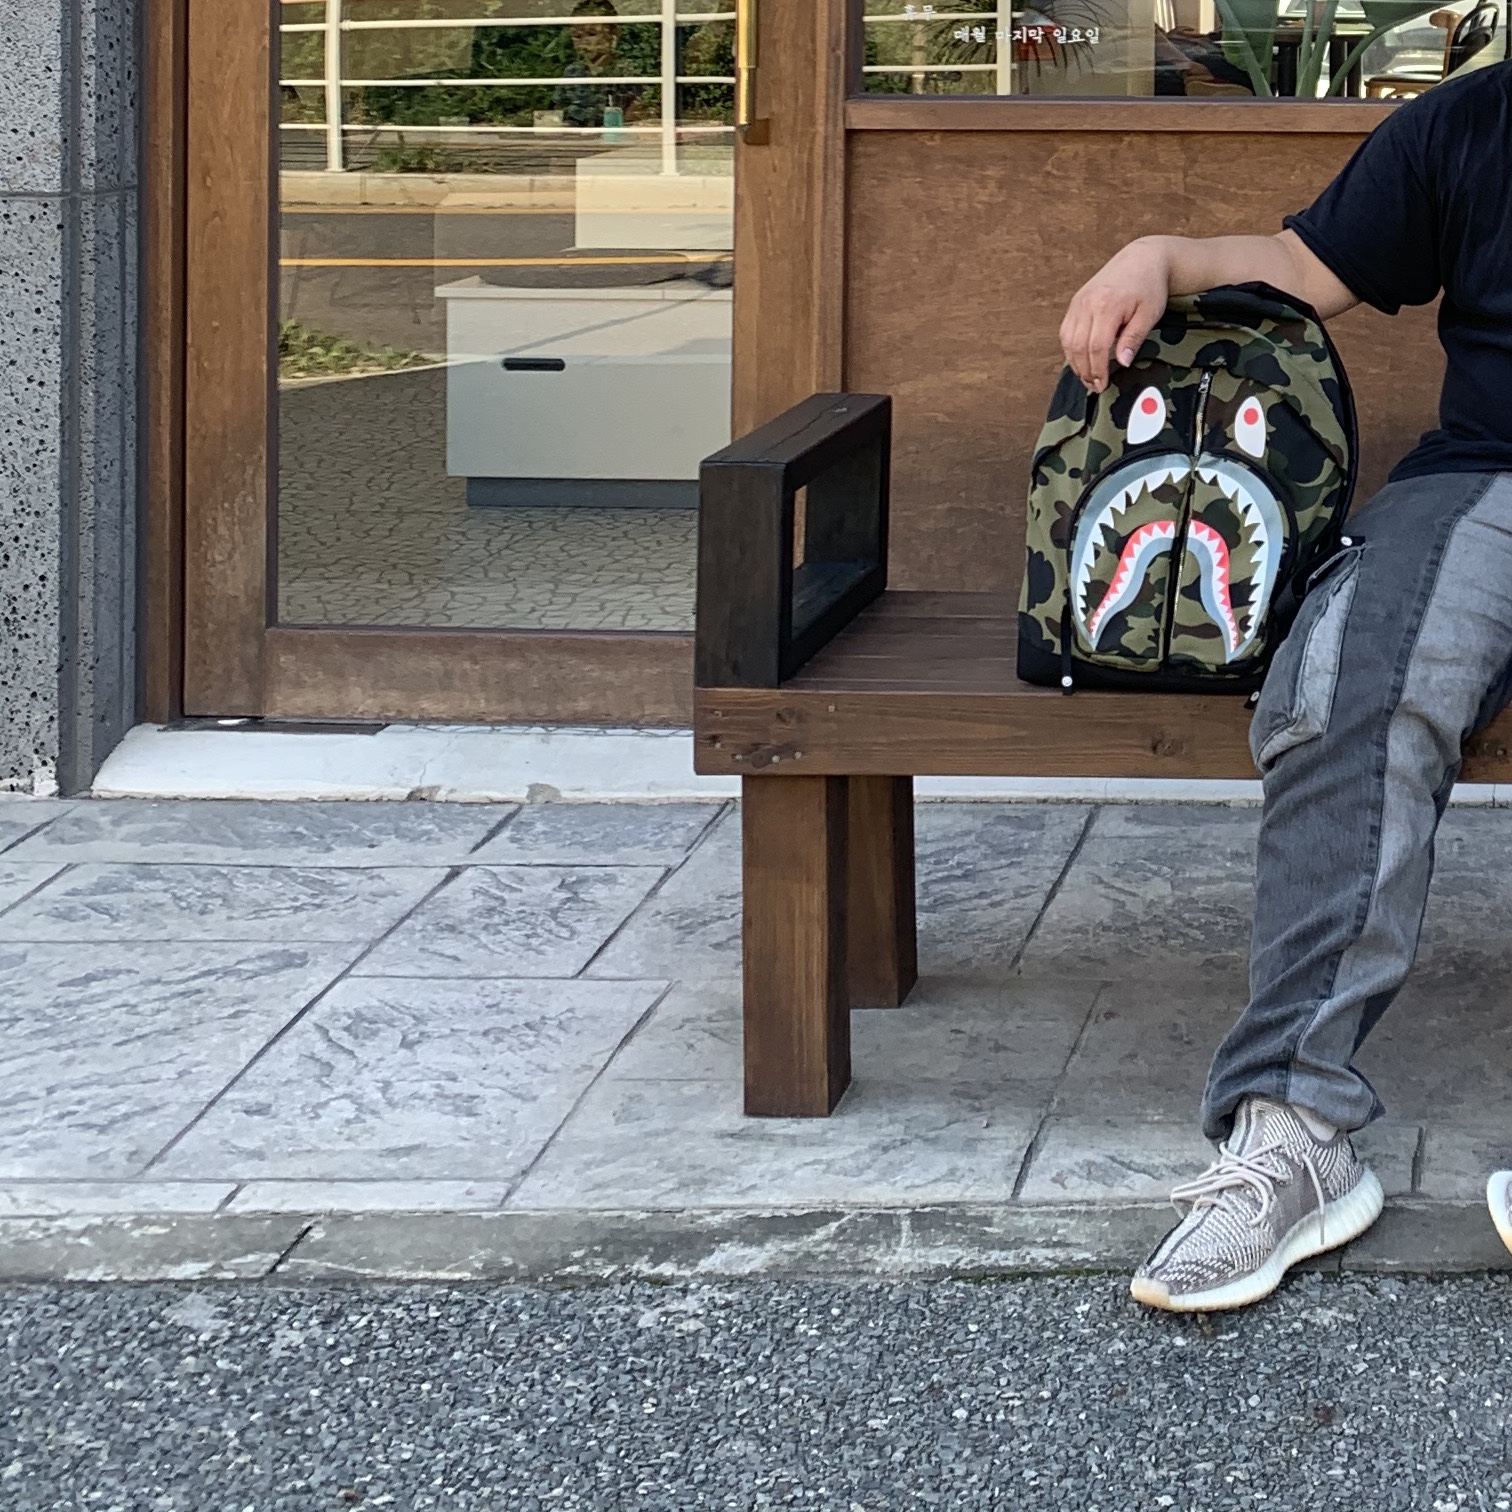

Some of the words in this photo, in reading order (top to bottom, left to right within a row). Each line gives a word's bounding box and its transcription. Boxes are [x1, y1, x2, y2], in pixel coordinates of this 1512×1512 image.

[953, 25, 986, 43] 매월
[995, 26, 1045, 44] 마지막
[1052, 27, 1100, 44] 일요일
